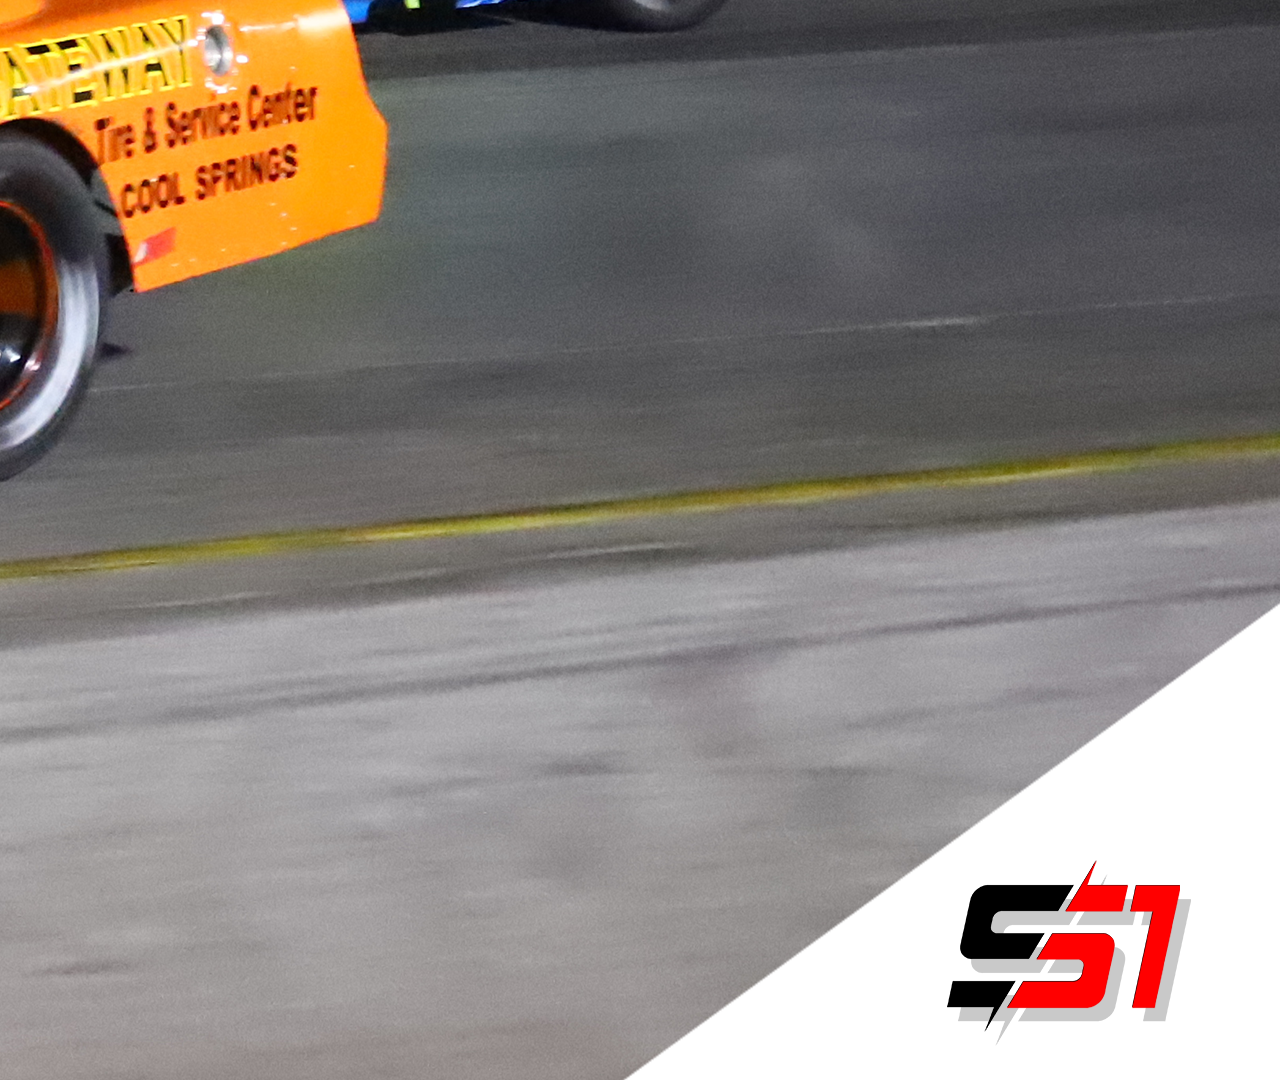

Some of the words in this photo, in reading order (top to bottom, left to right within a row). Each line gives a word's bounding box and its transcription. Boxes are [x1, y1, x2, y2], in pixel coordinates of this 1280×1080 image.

[93, 116, 135, 165] Tire
[165, 100, 241, 149] Service
[247, 81, 318, 131] Center
[120, 173, 186, 219] COOL
[194, 143, 299, 201] SPRINGS
